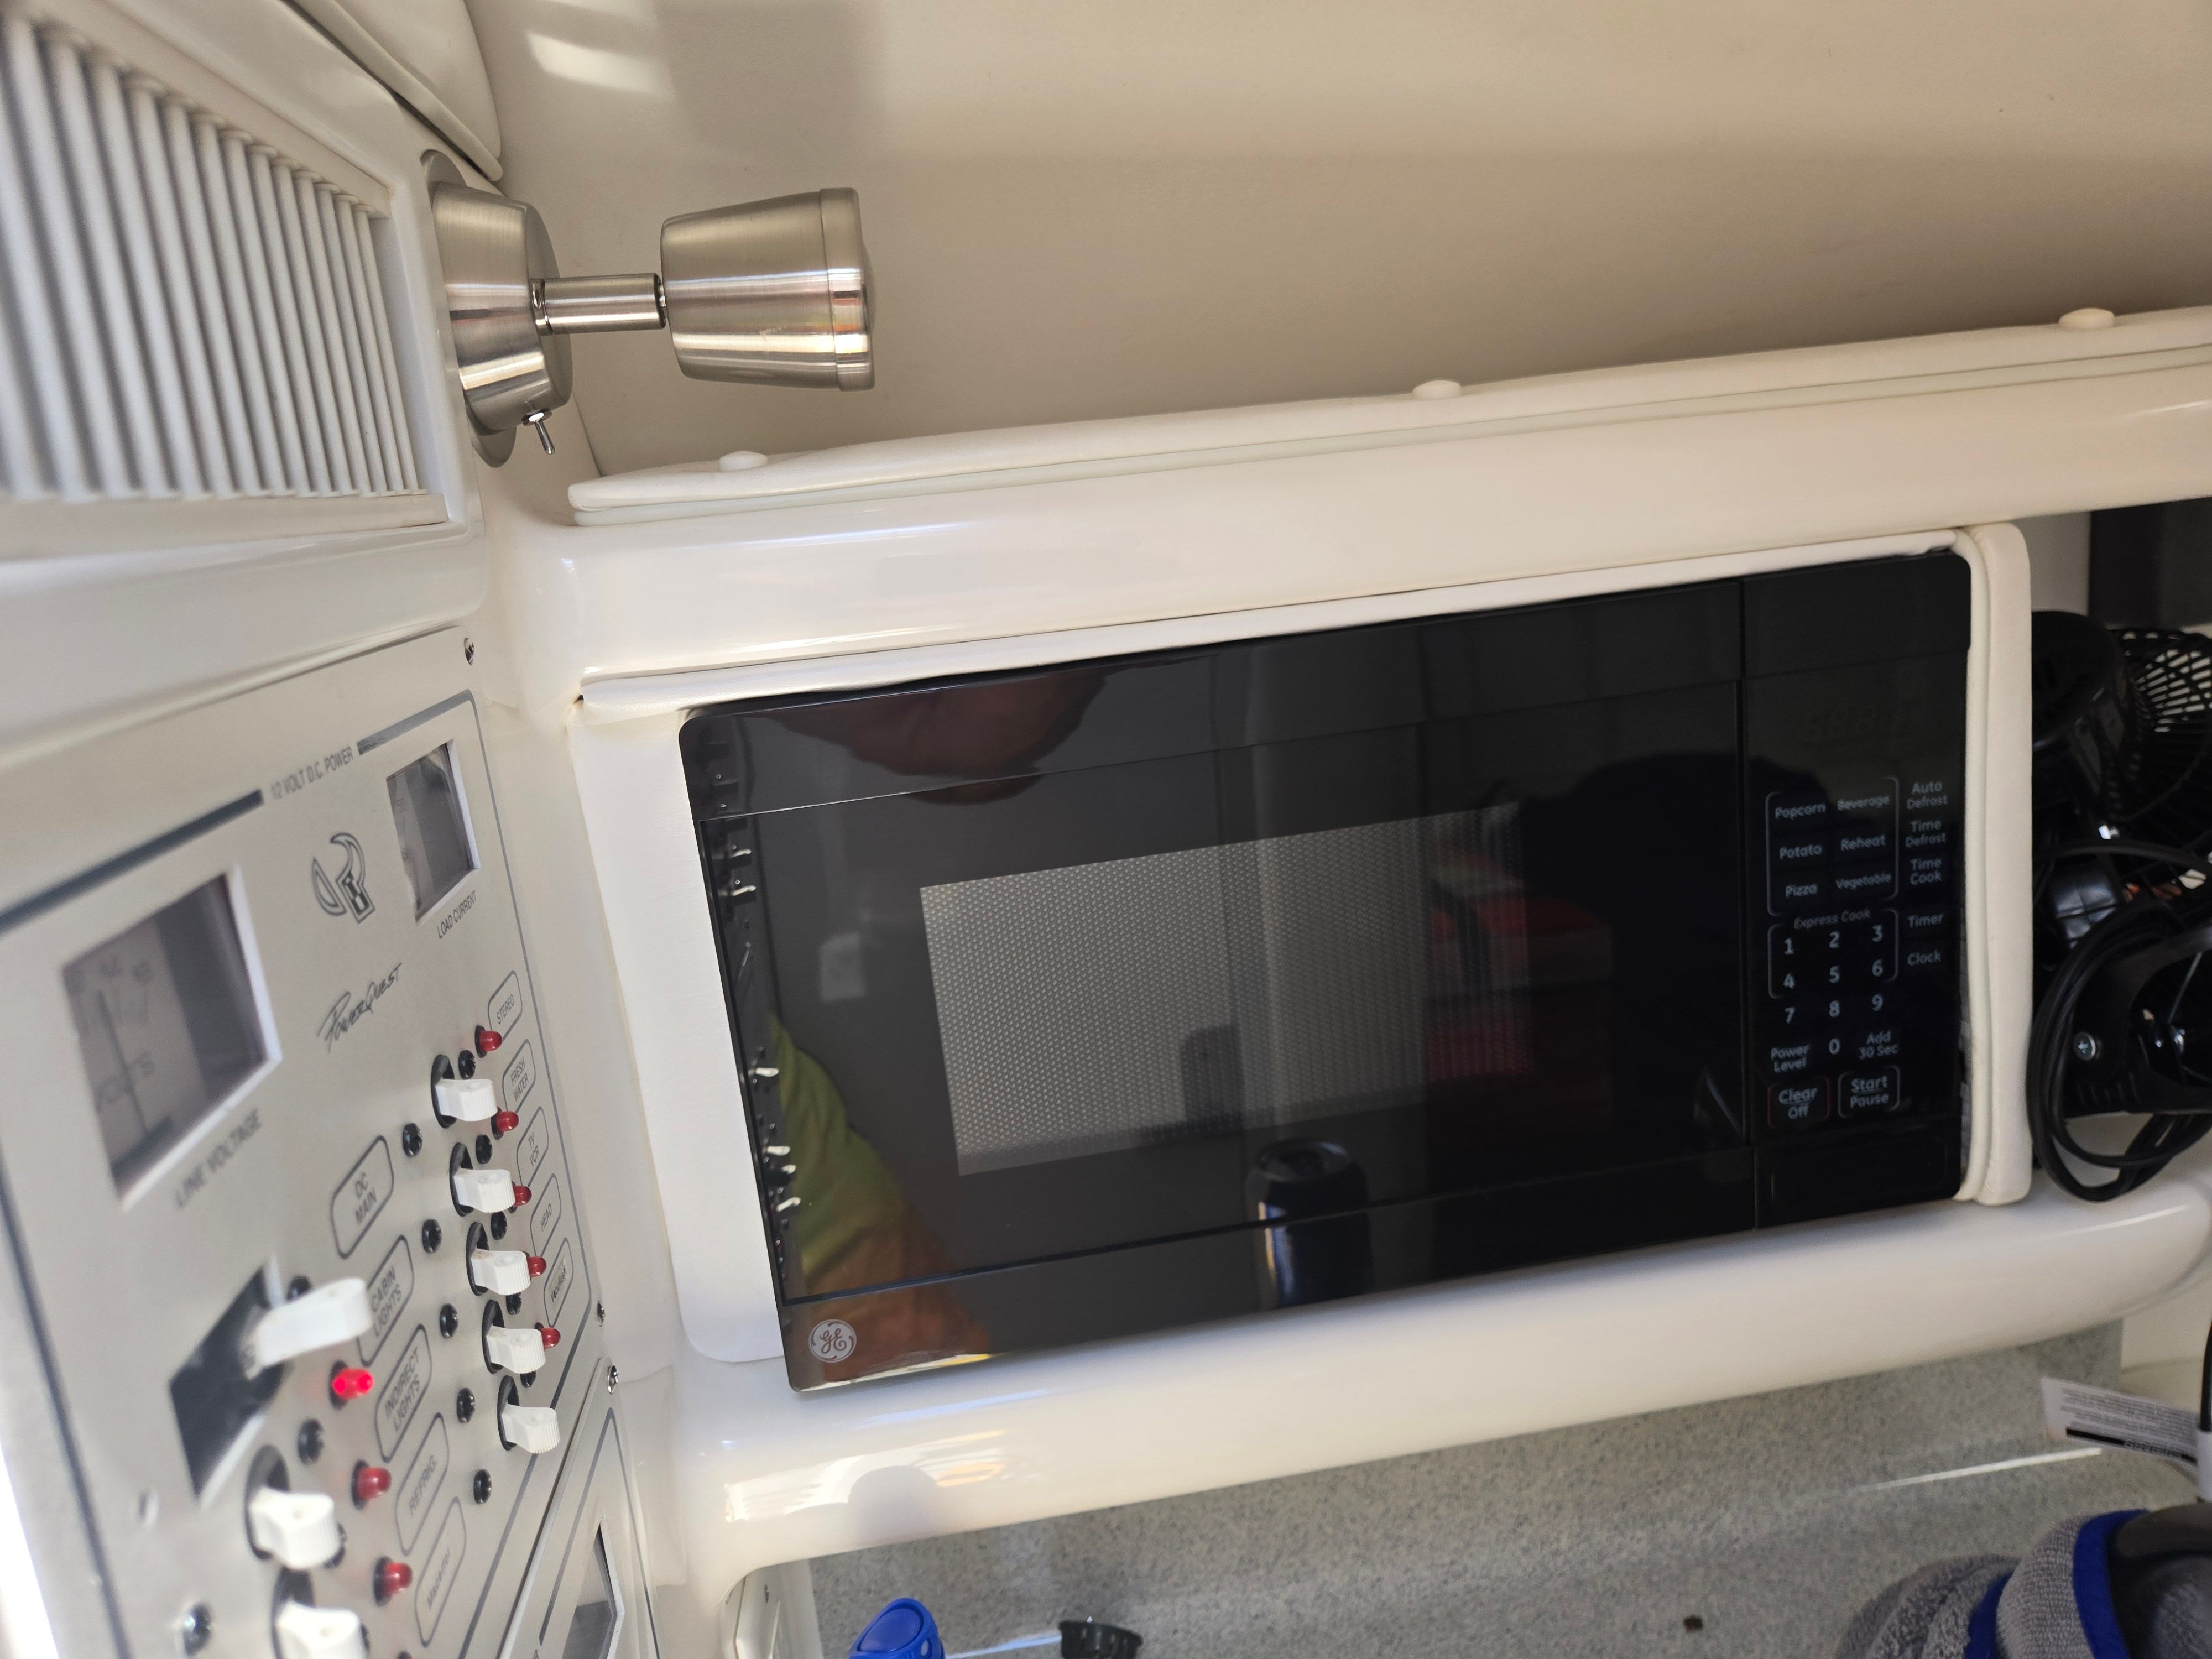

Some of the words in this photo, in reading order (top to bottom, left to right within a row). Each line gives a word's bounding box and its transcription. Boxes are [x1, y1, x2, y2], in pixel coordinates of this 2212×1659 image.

[283, 769, 305, 794] VOLT
[324, 745, 353, 773] POWER
[1912, 781, 1943, 795] Auto
[1837, 794, 1890, 811] Beverage
[1906, 795, 1948, 810] Defrost
[1775, 804, 1826, 820] Popcorn
[1911, 819, 1942, 832] Time
[1840, 834, 1886, 852] Reheat
[1905, 833, 1946, 848] Defrost
[1780, 844, 1823, 860] Potato
[1910, 858, 1942, 871] Time
[1836, 873, 1892, 890] Vegetable
[1910, 870, 1942, 885] Cook
[1785, 883, 1818, 898] Pizza
[437, 915, 453, 940] LOAD
[453, 890, 477, 923] CURRENT
[1794, 914, 1839, 930] Express
[1841, 908, 1871, 924] Cook
[1907, 914, 1944, 928] Timer
[1829, 931, 1840, 948] 2
[1872, 925, 1883, 942] 3
[1784, 938, 1794, 955] 1
[1907, 950, 1942, 966] Clock
[1829, 966, 1840, 983] 5
[1872, 959, 1883, 977] 6
[1783, 973, 1796, 990] 4
[497, 993, 514, 1025] STEREO
[1829, 1000, 1840, 1018] 8
[1872, 993, 1883, 1011] 9
[1785, 1006, 1795, 1025] 7
[1866, 1030, 1891, 1045] Add
[1771, 1045, 1811, 1060] Power
[1829, 1038, 1840, 1055] 0
[1859, 1046, 1874, 1060] 30
[1879, 1043, 1898, 1056] Sec
[510, 1057, 526, 1087] FRESH
[1773, 1057, 1807, 1073] Level
[513, 1072, 529, 1102] WATER
[1851, 1076, 1888, 1093] Start
[1778, 1087, 1818, 1104] Clear
[1850, 1094, 1889, 1109] Pause
[1788, 1104, 1809, 1119] Off
[528, 1131, 535, 1149] TV
[174, 1164, 206, 1210] LINE
[207, 1107, 262, 1173] VOLTAGE
[529, 1145, 540, 1167] VCR
[355, 1172, 368, 1199] DC
[356, 1187, 377, 1226] MAIN
[540, 1203, 552, 1232] HEAD
[371, 1265, 396, 1312] CABIN
[373, 1284, 401, 1338] LIGHTS
[385, 1346, 419, 1420] INDIRECT
[393, 1374, 420, 1432] LIGHTS
